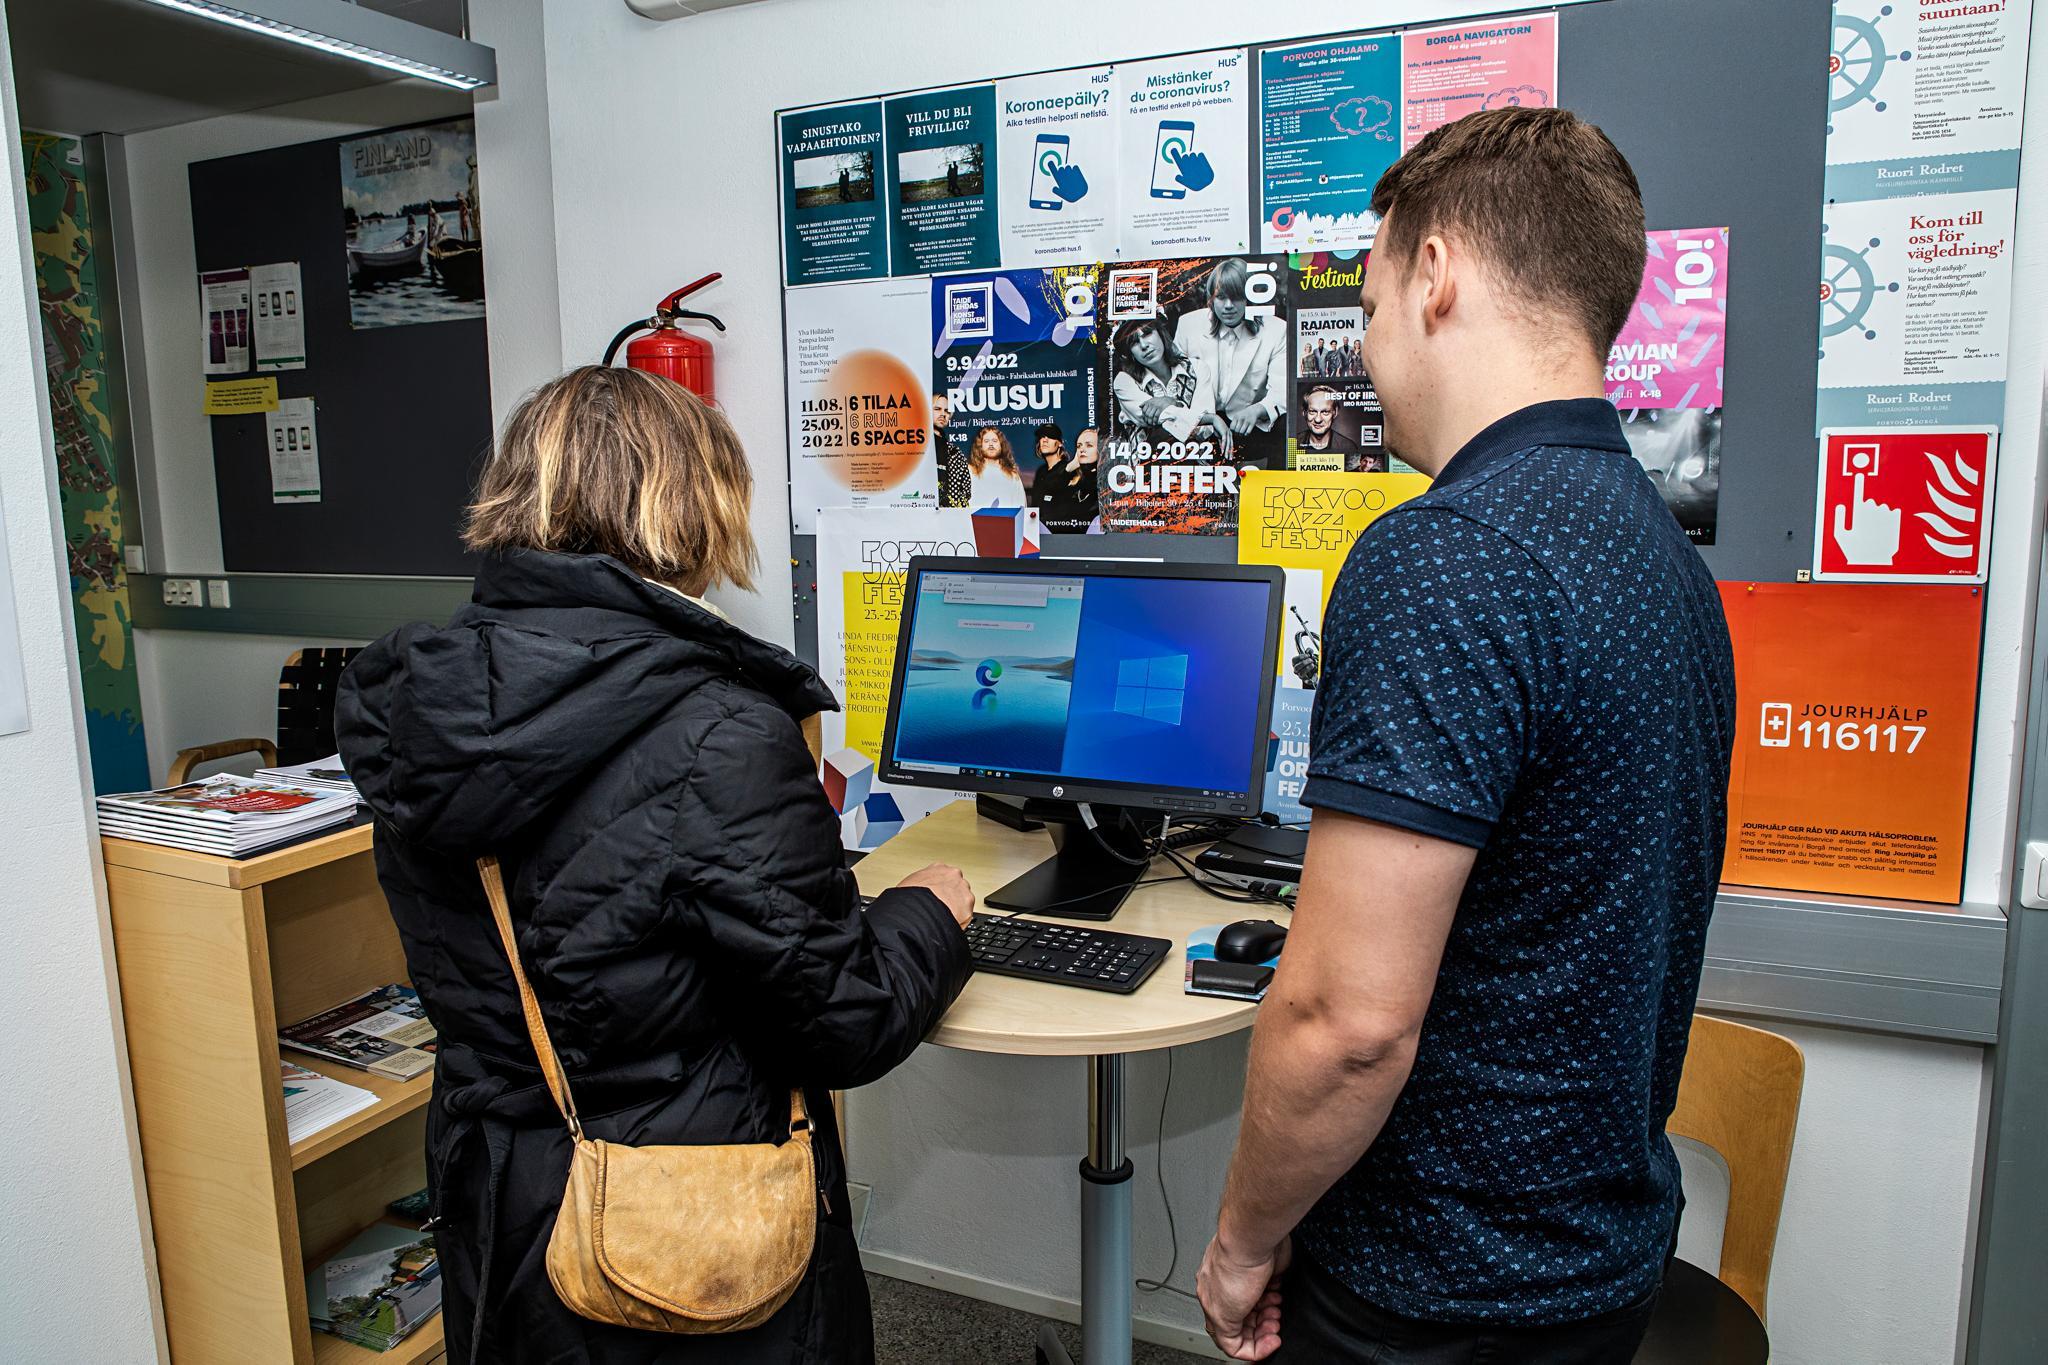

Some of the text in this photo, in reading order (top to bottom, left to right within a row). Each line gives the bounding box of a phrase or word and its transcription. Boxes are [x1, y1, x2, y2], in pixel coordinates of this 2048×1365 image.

[1918, 0, 2006, 21] suuntaan!
[1426, 26, 1532, 46] BORGÅ NAVIGATORN
[1460, 42, 1470, 50] dig
[1470, 40, 1488, 48] under
[1282, 44, 1379, 62] PORVOON OHJAAMO
[1218, 58, 1236, 68] HUS
[1092, 75, 1108, 84] HUS
[1146, 70, 1212, 88] Misstänker
[1130, 80, 1230, 102] du coronavirus?
[1006, 90, 1109, 114] Koronaepäily?
[1130, 106, 1138, 114] Få
[1149, 103, 1168, 112] testtid
[1192, 98, 1202, 108] på
[1203, 97, 1232, 105] webben.
[906, 105, 972, 124] VILL DU BLI
[1024, 116, 1046, 126] testiin
[1048, 112, 1078, 122] helposti
[1080, 108, 1108, 119] netistä.
[802, 121, 861, 138] SINUSTAKO
[909, 119, 970, 137] FRIVILLIG?
[354, 134, 432, 170] FINLAND
[787, 132, 881, 154] VAPAAEHTOINEN?
[1877, 164, 1964, 179] Ruori Rodret
[1910, 210, 1984, 230] Kom till
[1152, 235, 1211, 246] koronabotti.hus.fi/sv
[1908, 228, 1964, 244] oss för
[1034, 244, 1082, 255] koronabotti.hus.fi
[1908, 240, 2004, 264] vägledning!
[1300, 264, 1362, 290] Festival
[1674, 238, 1714, 305] 10!
[1244, 262, 1278, 322] 10!
[1065, 274, 1094, 332] 10!
[1116, 300, 1150, 308] FABRIKEN
[953, 316, 985, 324] FABRIKEN
[1300, 319, 1355, 331] RAJATON
[946, 353, 1018, 371] 9.9.2022
[1607, 344, 1678, 362] AVIAN
[980, 370, 1078, 382] klubi-ilta Fabriksalens klubbkväll
[1604, 364, 1662, 382] ROUP
[850, 392, 912, 411] 6 TILAA
[947, 384, 1064, 412] RUUSUT
[1087, 368, 1096, 427] TAIDETEHDAS.FI
[1324, 392, 1362, 400] BEST OF
[1640, 390, 1662, 398] K-18
[1866, 391, 1952, 404] Ruori Rodret
[801, 398, 843, 412] 11.08.
[802, 418, 844, 432] 25.09.
[850, 412, 898, 428] 6 RUM
[948, 420, 966, 428] Liput
[973, 418, 1000, 428] Biljetter
[1001, 416, 1020, 426] 22,50
[1028, 416, 1054, 424] lippu.fi
[802, 434, 843, 448] 2022
[850, 429, 925, 446] 6 SPACES
[949, 434, 968, 442] K-18
[1108, 441, 1214, 460] 14.9.2022
[1300, 464, 1341, 472] KARTANO-
[1107, 464, 1260, 494] CLIFTER
[1205, 499, 1232, 510] lippu.fi
[1264, 486, 1386, 510] PORVOO
[1262, 507, 1344, 528] JAZZ
[1262, 526, 1343, 550] FEST
[862, 540, 976, 563] PORVOO
[838, 632, 862, 640] LINDA
[840, 643, 882, 654] MÄENSIVU
[844, 656, 866, 664] SONS
[840, 668, 864, 676] JUKKA
[836, 679, 886, 690] MYA MIKKO
[850, 692, 888, 702] KERÄNEN
[1801, 703, 1929, 722] JOURHJÄLP
[1798, 720, 1927, 754] 116117
[1742, 822, 1786, 831] JOURHJÄLP
[1806, 826, 1822, 834] RÅD
[1868, 830, 1938, 843] HÄLSOPROBLEM.
[1776, 834, 1834, 842] hälsovårdsservice
[1890, 842, 1938, 852] telefonrådgiv-
[1806, 844, 1826, 852] Borgå
[1893, 850, 1926, 858] Jourhjälp
[1746, 855, 1788, 863] hälsoärenden
[1854, 864, 1885, 872] veckoslut
[1908, 868, 1936, 876] nattetid.
